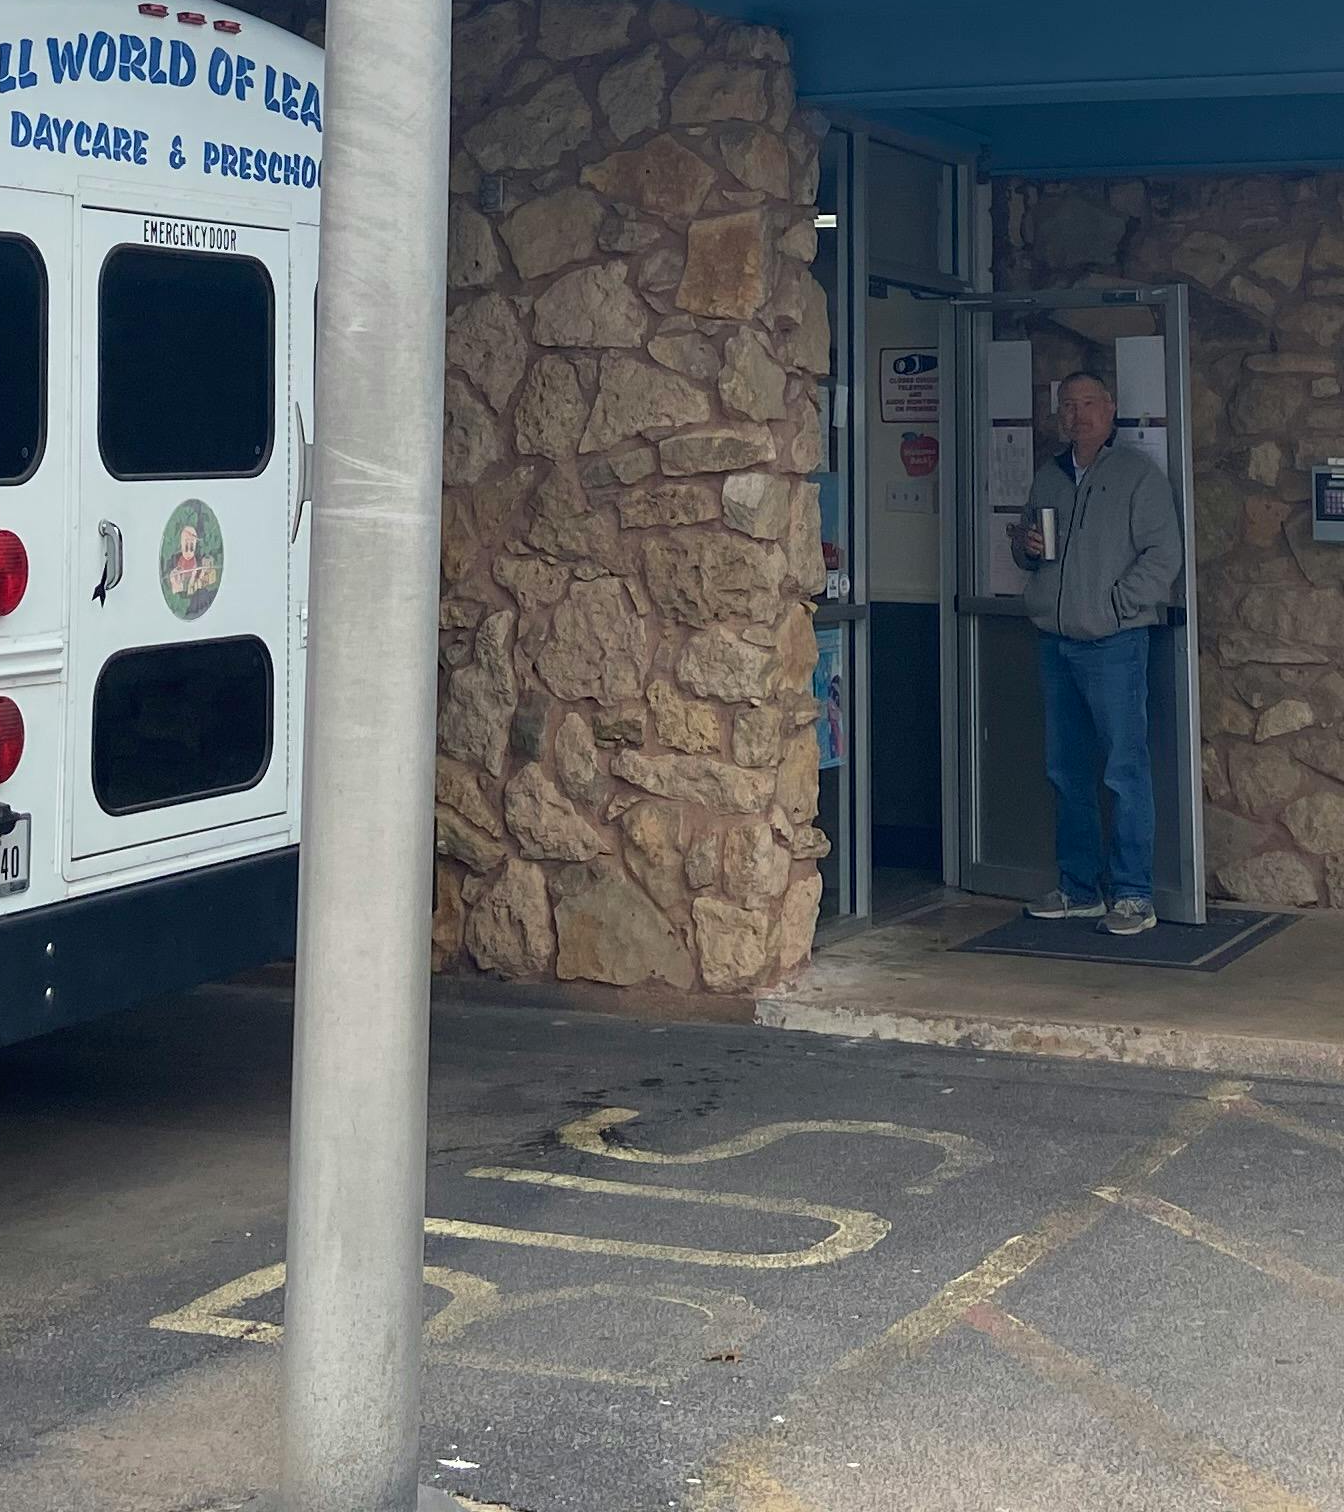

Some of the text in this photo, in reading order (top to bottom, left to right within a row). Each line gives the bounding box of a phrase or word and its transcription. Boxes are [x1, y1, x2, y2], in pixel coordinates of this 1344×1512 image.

[46, 30, 198, 88] WORLD
[207, 46, 256, 101] OF
[264, 64, 324, 134] LEA
[10, 110, 323, 189] DAYCARE & PRESCHO
[143, 219, 237, 251] EMERGENCY DOOR
